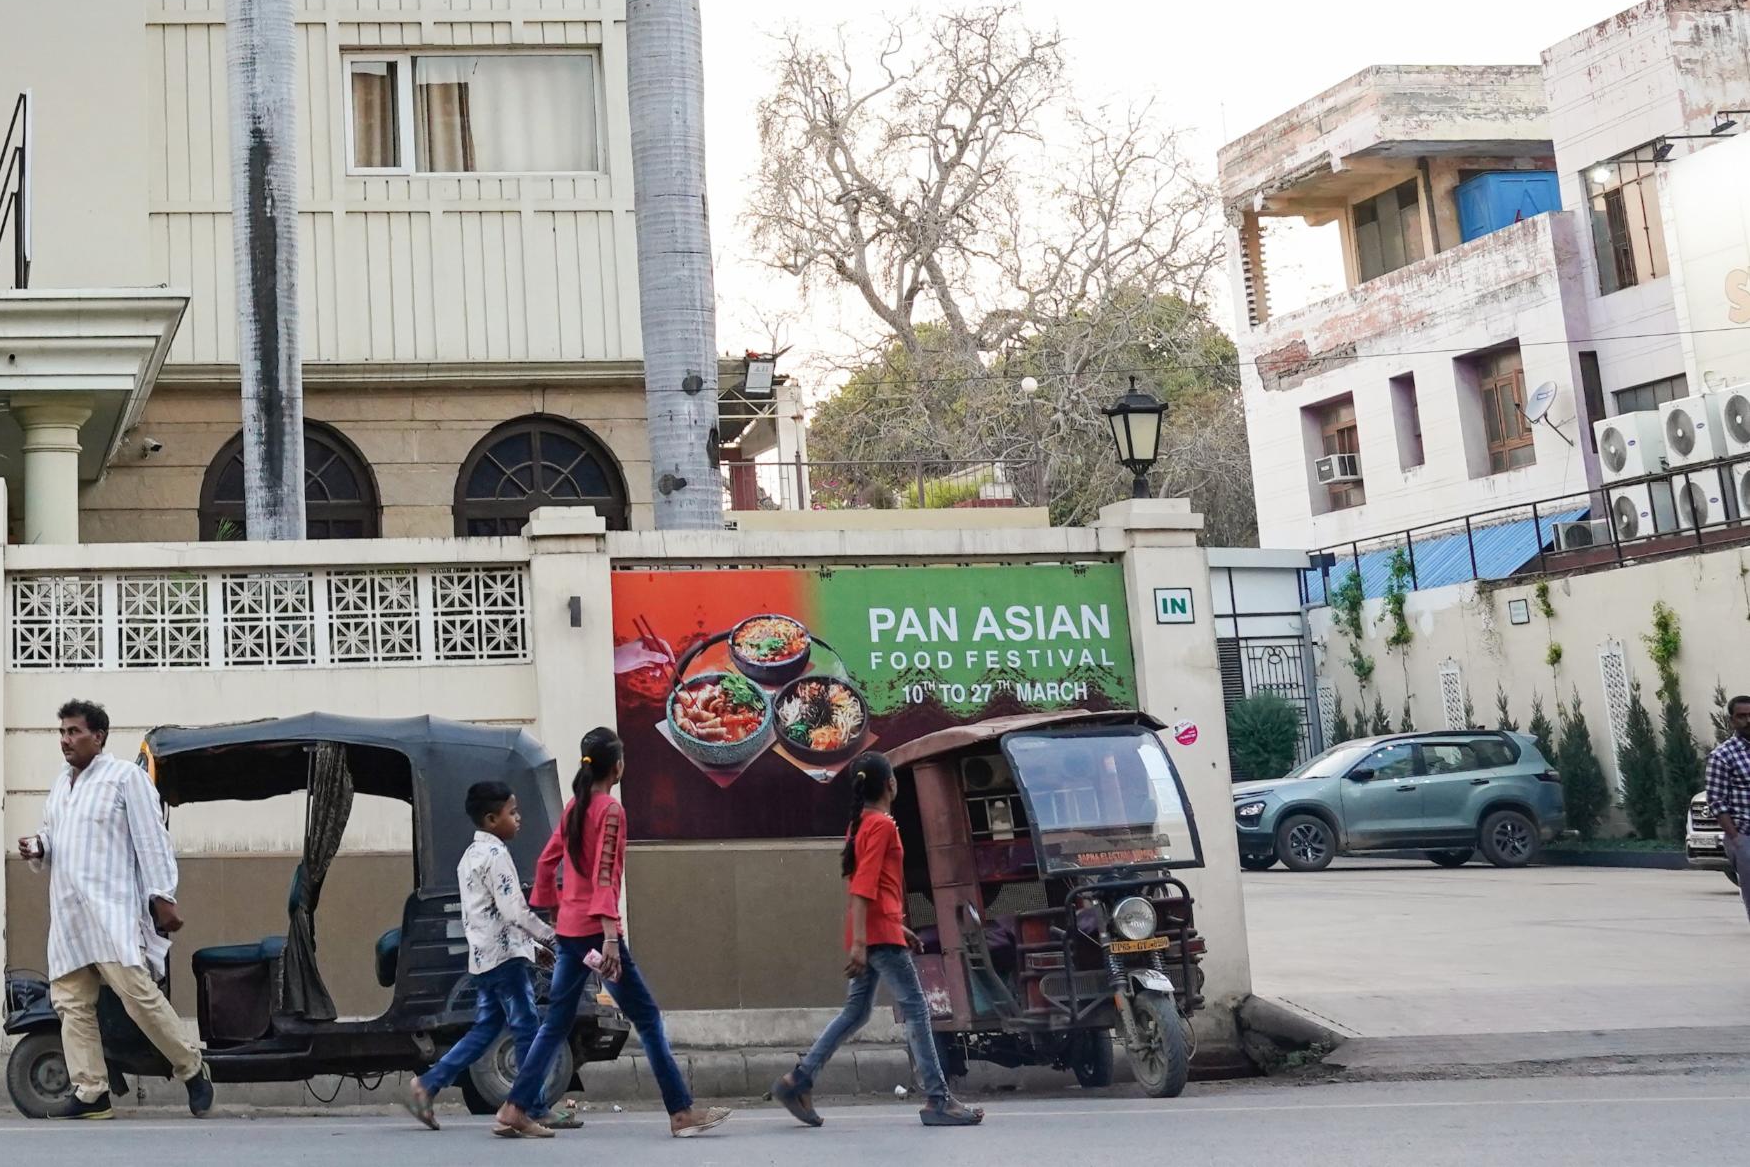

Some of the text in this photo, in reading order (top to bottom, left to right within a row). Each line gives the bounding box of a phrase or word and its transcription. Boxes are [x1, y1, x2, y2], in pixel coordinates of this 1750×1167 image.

[1162, 597, 1187, 615] IN
[868, 603, 1111, 643] PAN ASIAN
[870, 648, 1115, 670] FOOD FESTIVAL
[940, 683, 966, 703] TO
[971, 683, 992, 703] 27
[1016, 681, 1088, 702] MARCH
